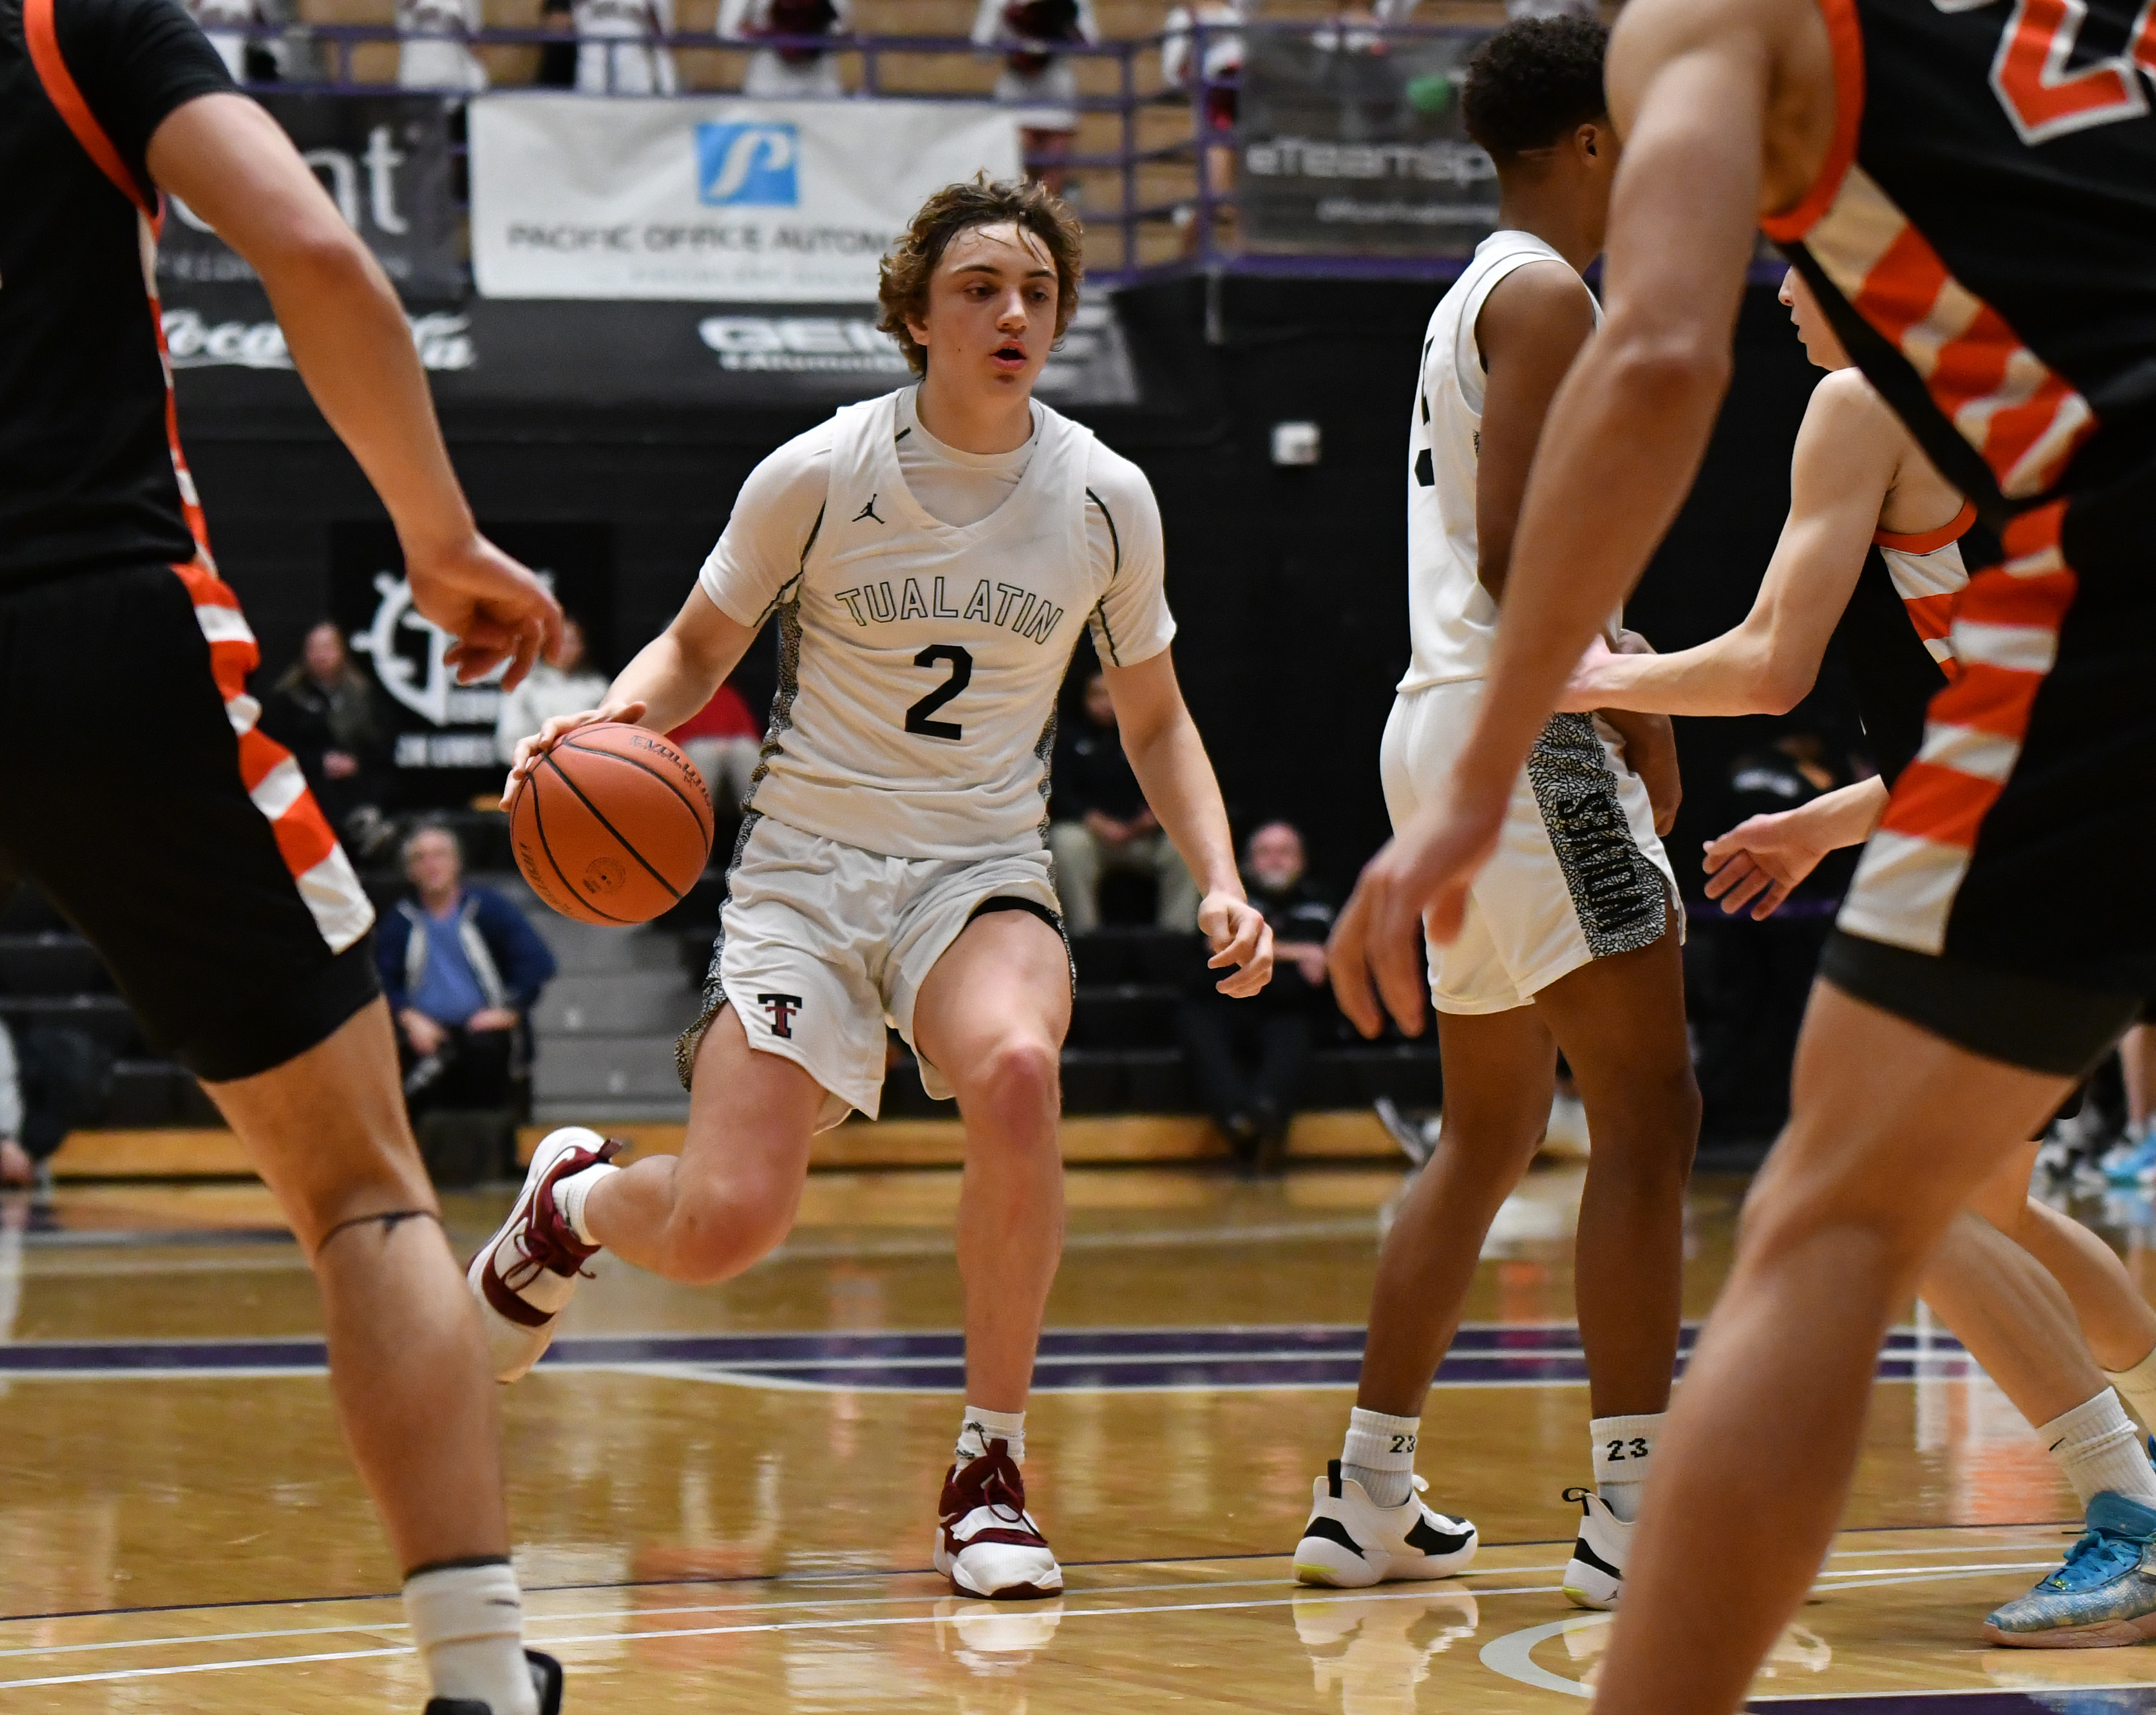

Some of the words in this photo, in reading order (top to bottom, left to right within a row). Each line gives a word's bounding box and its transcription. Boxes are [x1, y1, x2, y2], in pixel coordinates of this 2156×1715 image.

[506, 224, 634, 252] PACIFIC
[643, 224, 760, 253] OFFICE
[772, 224, 892, 254] AUTOM
[835, 576, 1065, 645] TUALATIN
[904, 643, 973, 741] 2
[1556, 790, 1651, 934] WOLVES
[1389, 1434, 1418, 1454] 23
[1606, 1437, 1649, 1462] 23
